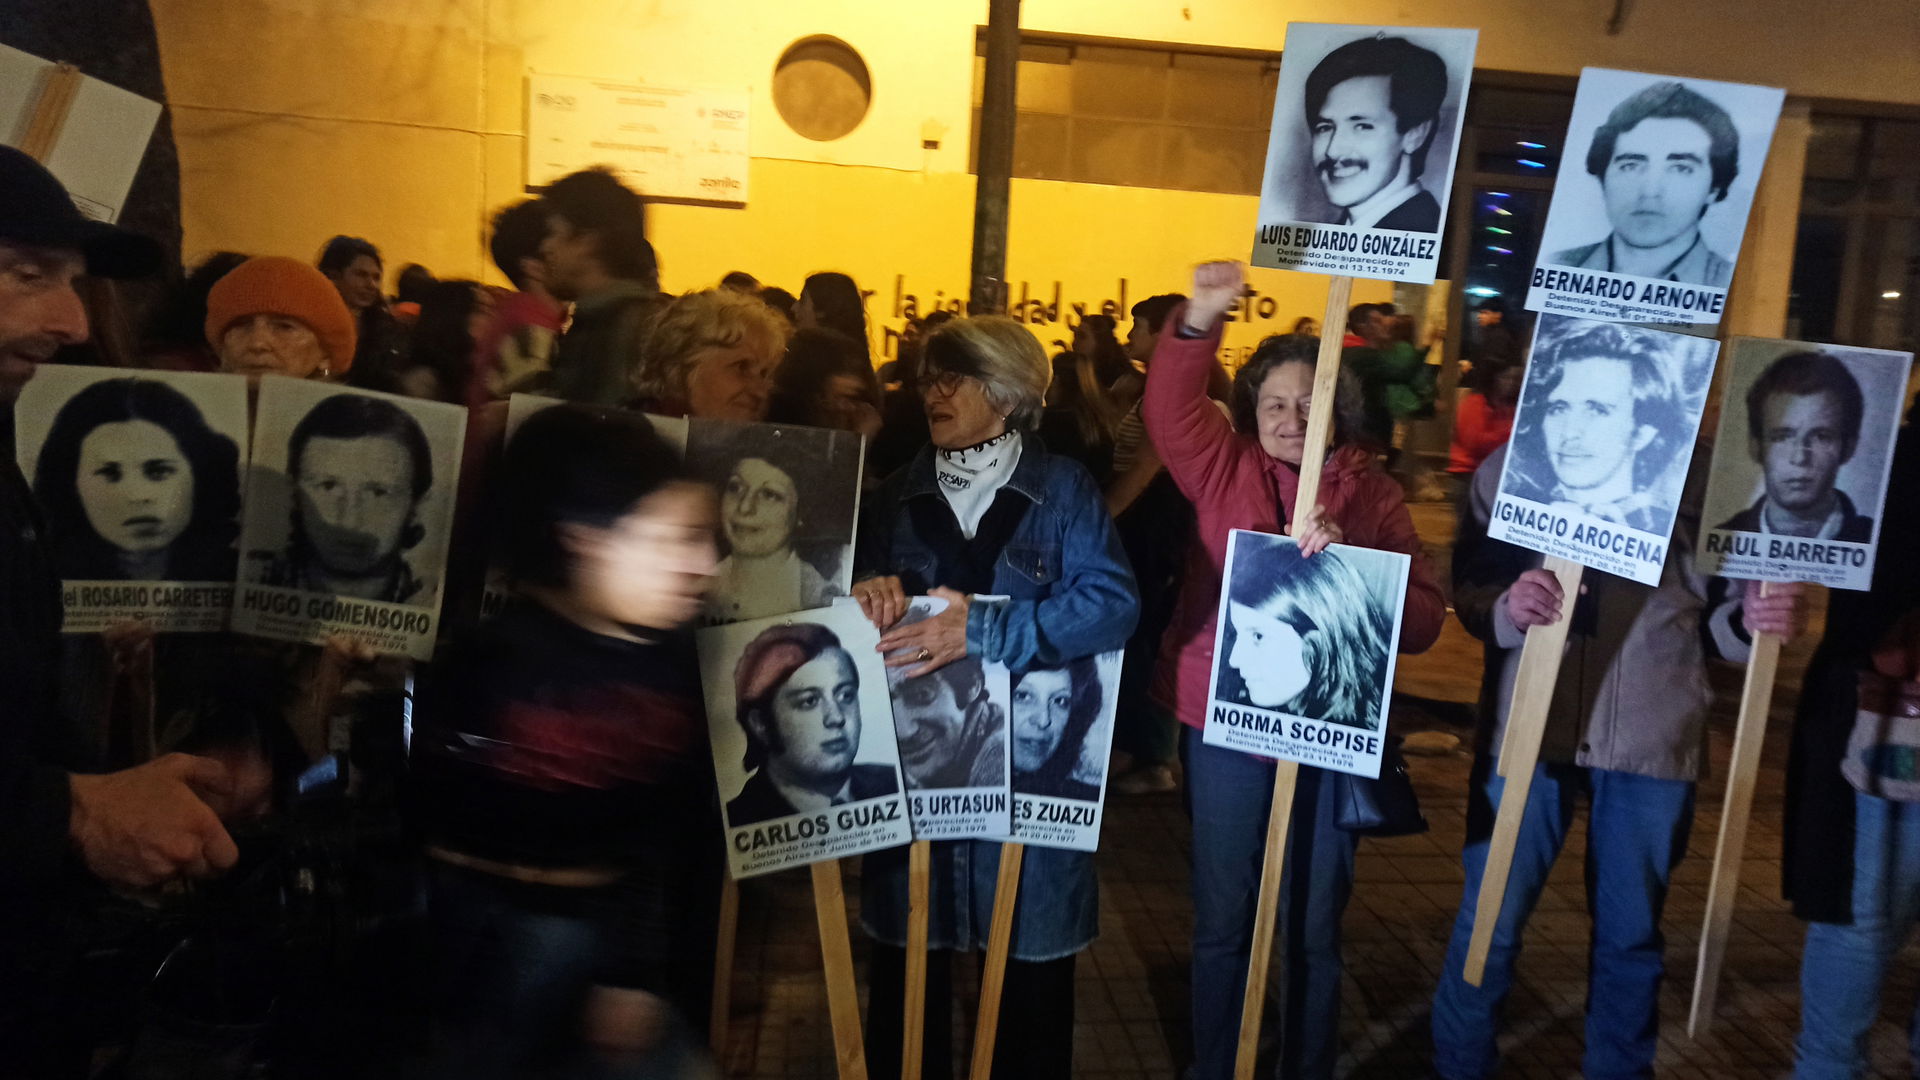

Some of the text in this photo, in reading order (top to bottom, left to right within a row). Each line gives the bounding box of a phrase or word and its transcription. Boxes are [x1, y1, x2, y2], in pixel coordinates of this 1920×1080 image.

[1260, 224, 1436, 259] LUIS EDUARDO GONZÁLEZ
[1277, 247, 1321, 259] Detenido
[1278, 257, 1336, 269] Montevideo
[1352, 264, 1406, 275] 13.12.1974
[1532, 268, 1725, 314] BERNARDO ARNONE
[1548, 292, 1598, 306] Detenido
[1545, 300, 1586, 313] Buenos
[1590, 307, 1618, 317] Aires
[1495, 500, 1663, 566] IGNACIO AROCENA
[1705, 533, 1866, 568] RAUL BARRETO
[81, 587, 149, 607] ROSARIO
[243, 589, 300, 618] HUGO
[307, 598, 430, 635] GOMENSORO
[1213, 706, 1283, 736] NORMA
[1225, 735, 1261, 749] Buenos
[1265, 744, 1289, 755] Aires
[1228, 729, 1270, 743] Detenida
[929, 794, 1006, 815] URTASUN
[1036, 802, 1096, 827] ZUAZU
[735, 800, 902, 854] CARLOS GUAZ
